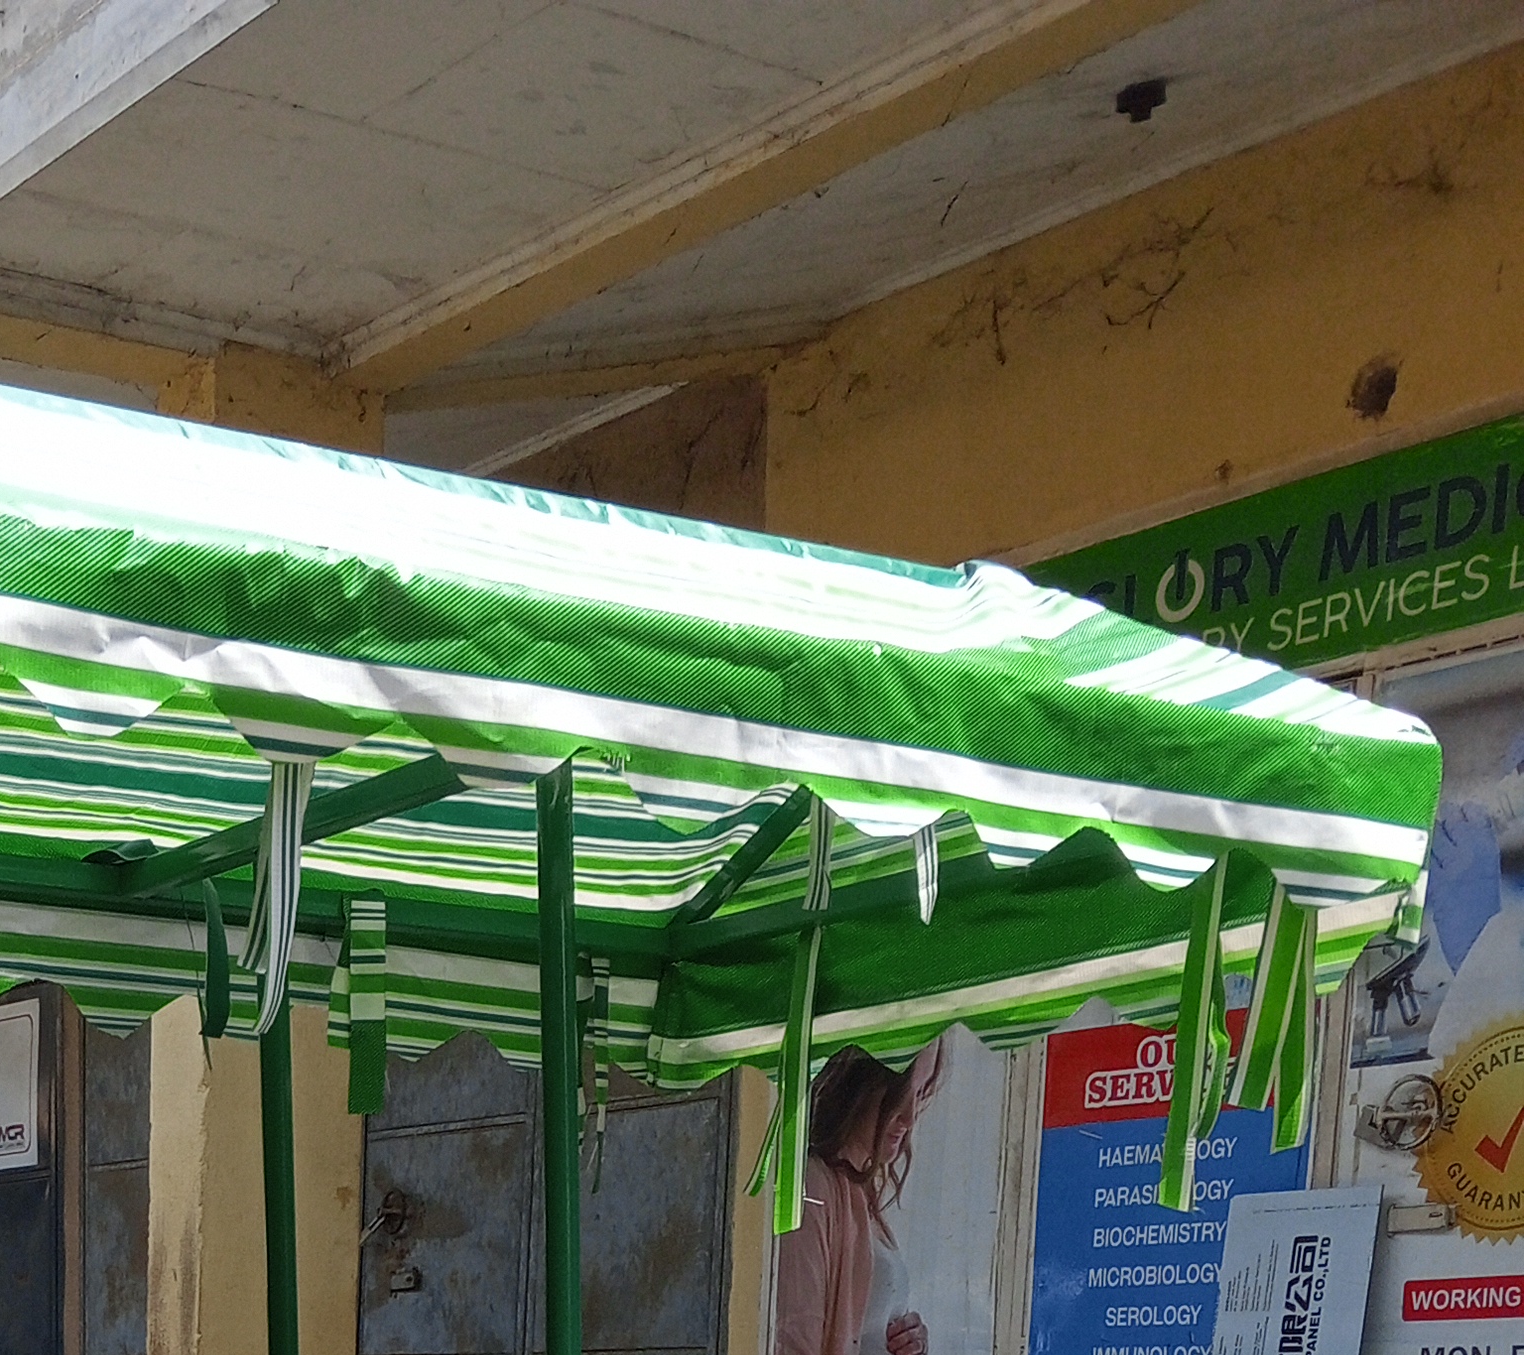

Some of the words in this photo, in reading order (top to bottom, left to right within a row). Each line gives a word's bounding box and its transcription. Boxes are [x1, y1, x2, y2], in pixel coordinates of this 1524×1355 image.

[1318, 463, 1524, 581] MEDI
[1267, 554, 1489, 652] SERVICES
[1441, 1045, 1524, 1133] ACCURATE
[1092, 1221, 1227, 1248] BIOCHEMISTRY
[1105, 1304, 1202, 1327] SEROLOGY
[1411, 1286, 1521, 1311] WORKING
